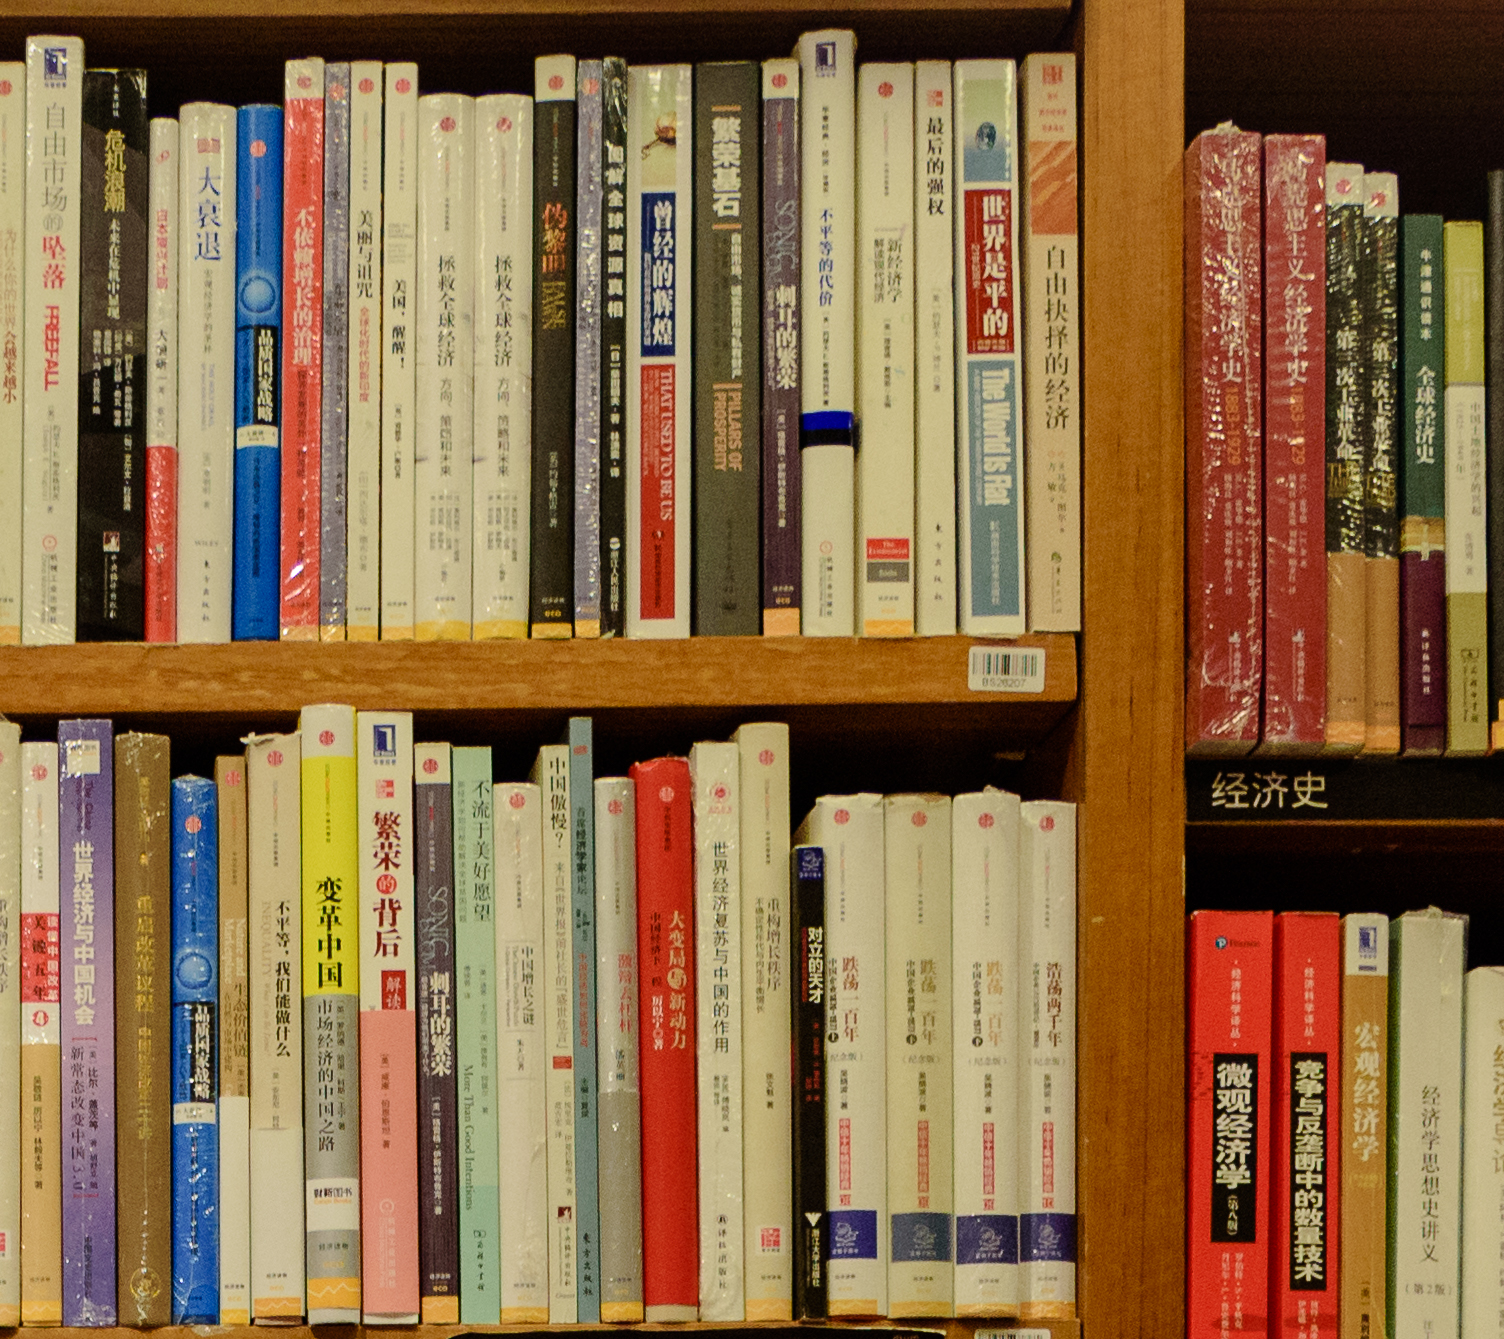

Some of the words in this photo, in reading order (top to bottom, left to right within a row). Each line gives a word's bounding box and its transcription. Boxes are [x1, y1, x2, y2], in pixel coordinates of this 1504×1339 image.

[194, 168, 223, 261] 大衰退
[926, 116, 945, 216] 最后的强权
[1044, 245, 1070, 431] 自由抉择的经济
[1211, 769, 1328, 809] 经济史
[316, 878, 343, 987] 变革中国
[373, 812, 402, 958] 繁荣的背后
[1216, 1062, 1251, 1189] 微观经济学
[1294, 1059, 1324, 1282] 竞争与反垄断中的数量技术
